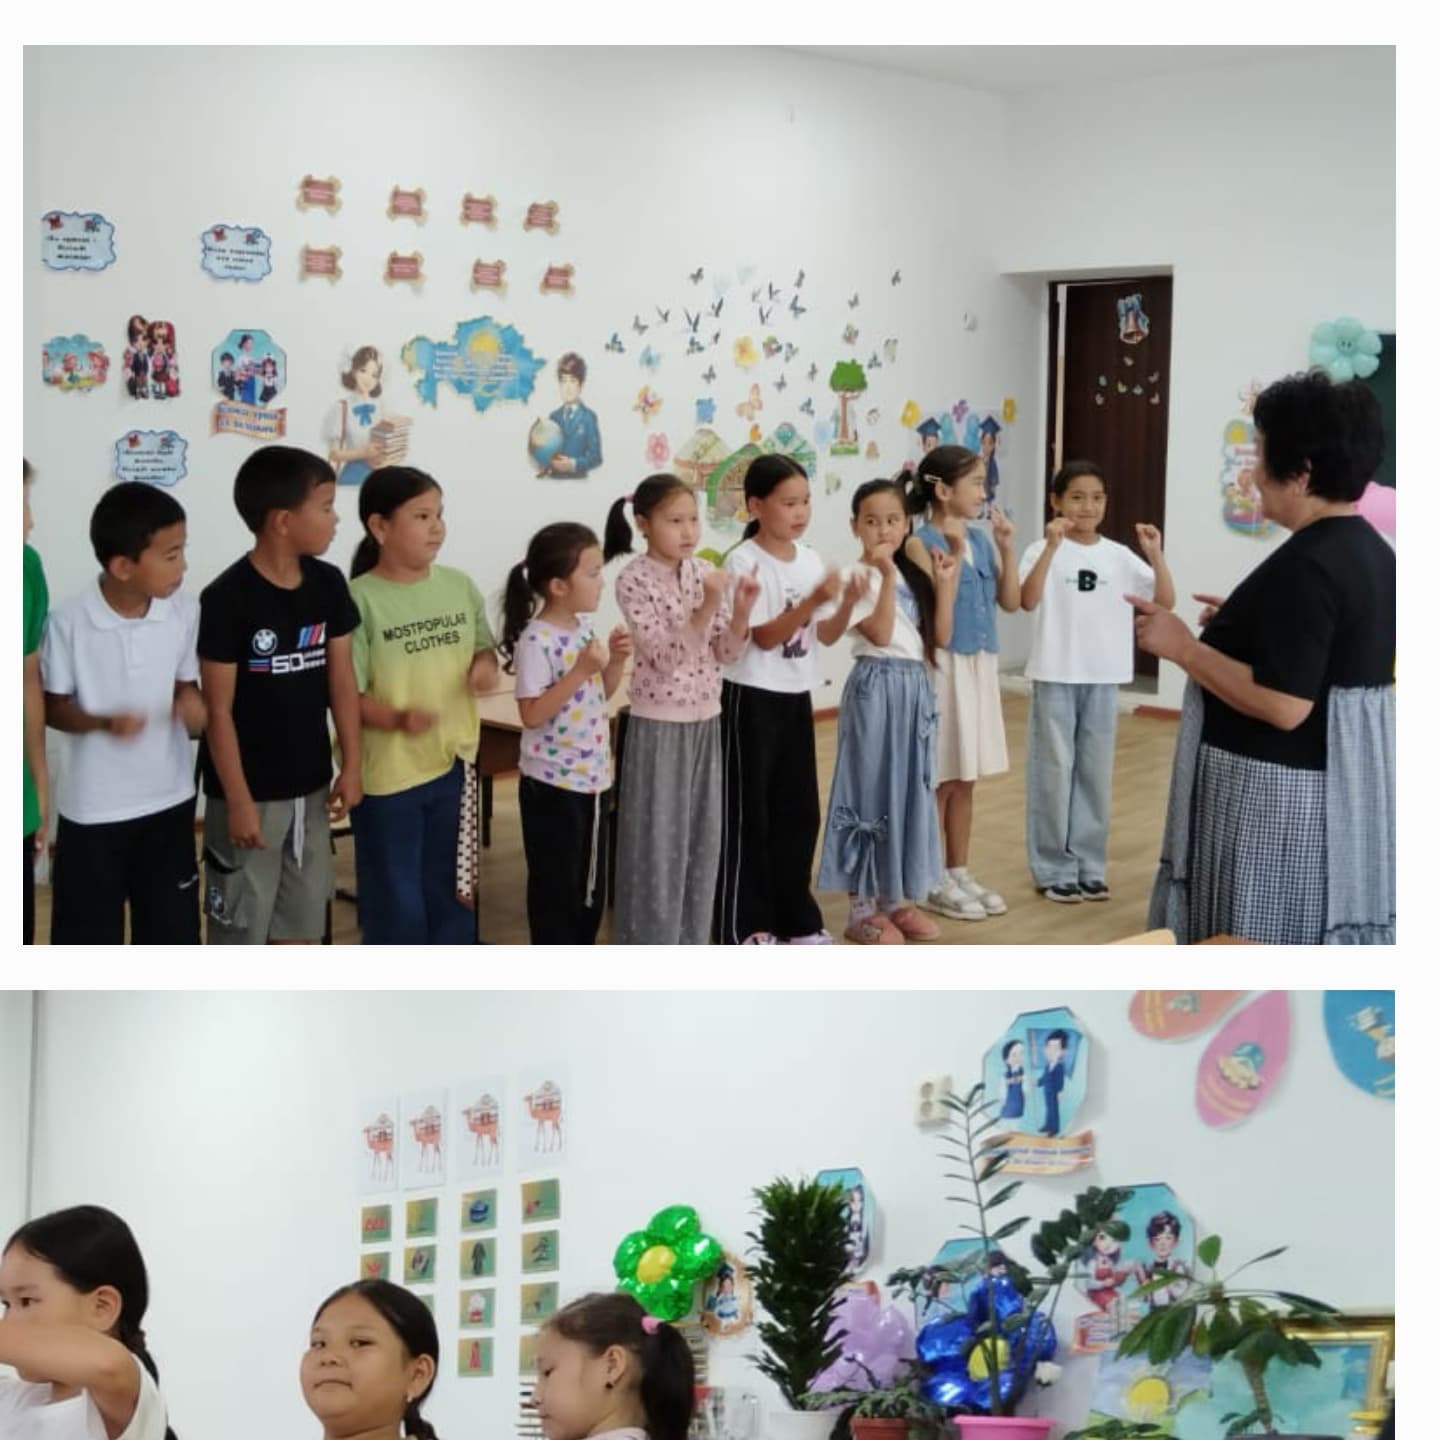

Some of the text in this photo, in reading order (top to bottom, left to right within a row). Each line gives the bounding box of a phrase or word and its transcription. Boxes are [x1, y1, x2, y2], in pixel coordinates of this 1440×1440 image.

[1078, 569, 1098, 592] B
[383, 613, 466, 642] MOSTPOPULAR
[404, 630, 460, 654] CLOTHES
